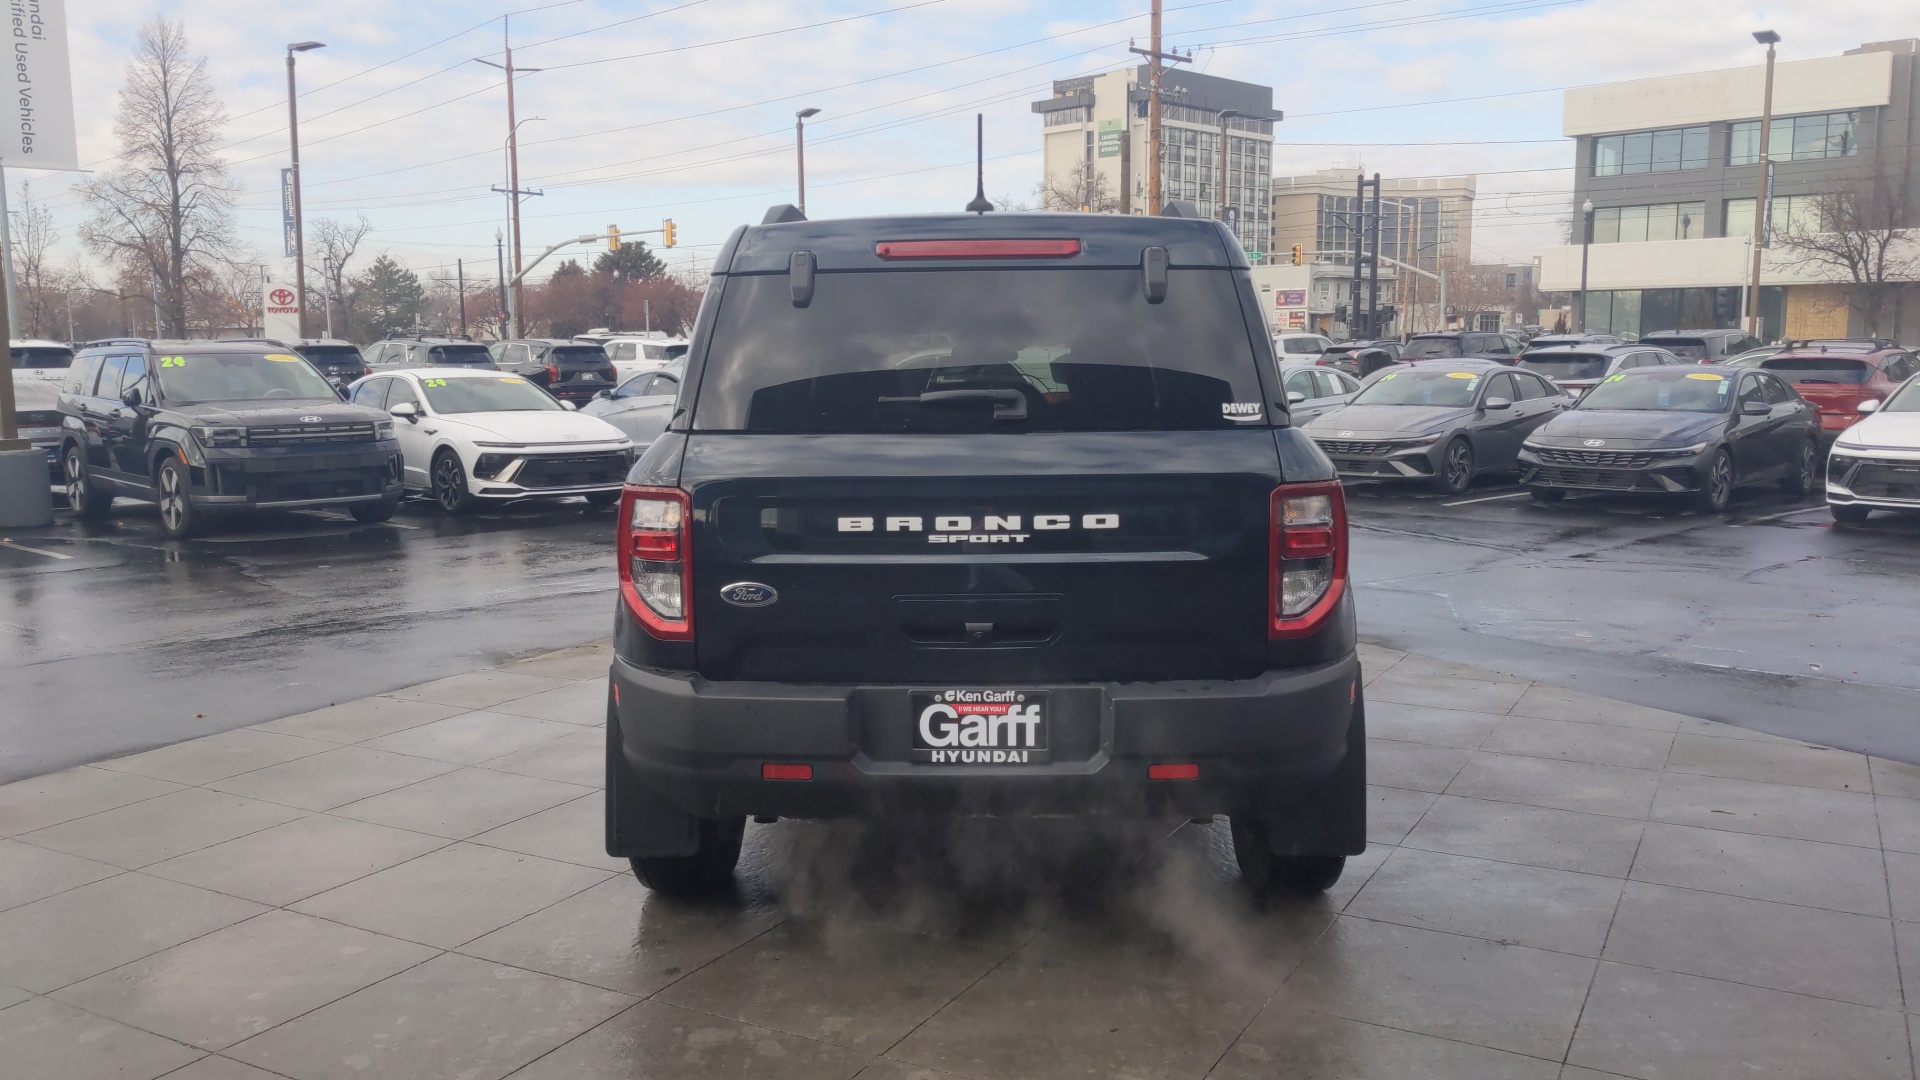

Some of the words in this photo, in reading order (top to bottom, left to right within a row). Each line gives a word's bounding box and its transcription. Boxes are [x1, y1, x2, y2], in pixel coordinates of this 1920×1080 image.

[15, 43, 31, 83] Used
[18, 87, 36, 154] Vehicles
[267, 306, 298, 314] TOYOTA
[161, 356, 186, 368] 24
[1222, 402, 1261, 414] DEWEY
[837, 513, 1120, 533] BRONCO
[928, 533, 1030, 544] SPORT
[732, 587, 764, 601] Ford
[956, 690, 981, 702] Ken
[983, 690, 1015, 702] Garff
[919, 703, 1041, 747] Garff
[931, 750, 1028, 763] HYUNDAI
